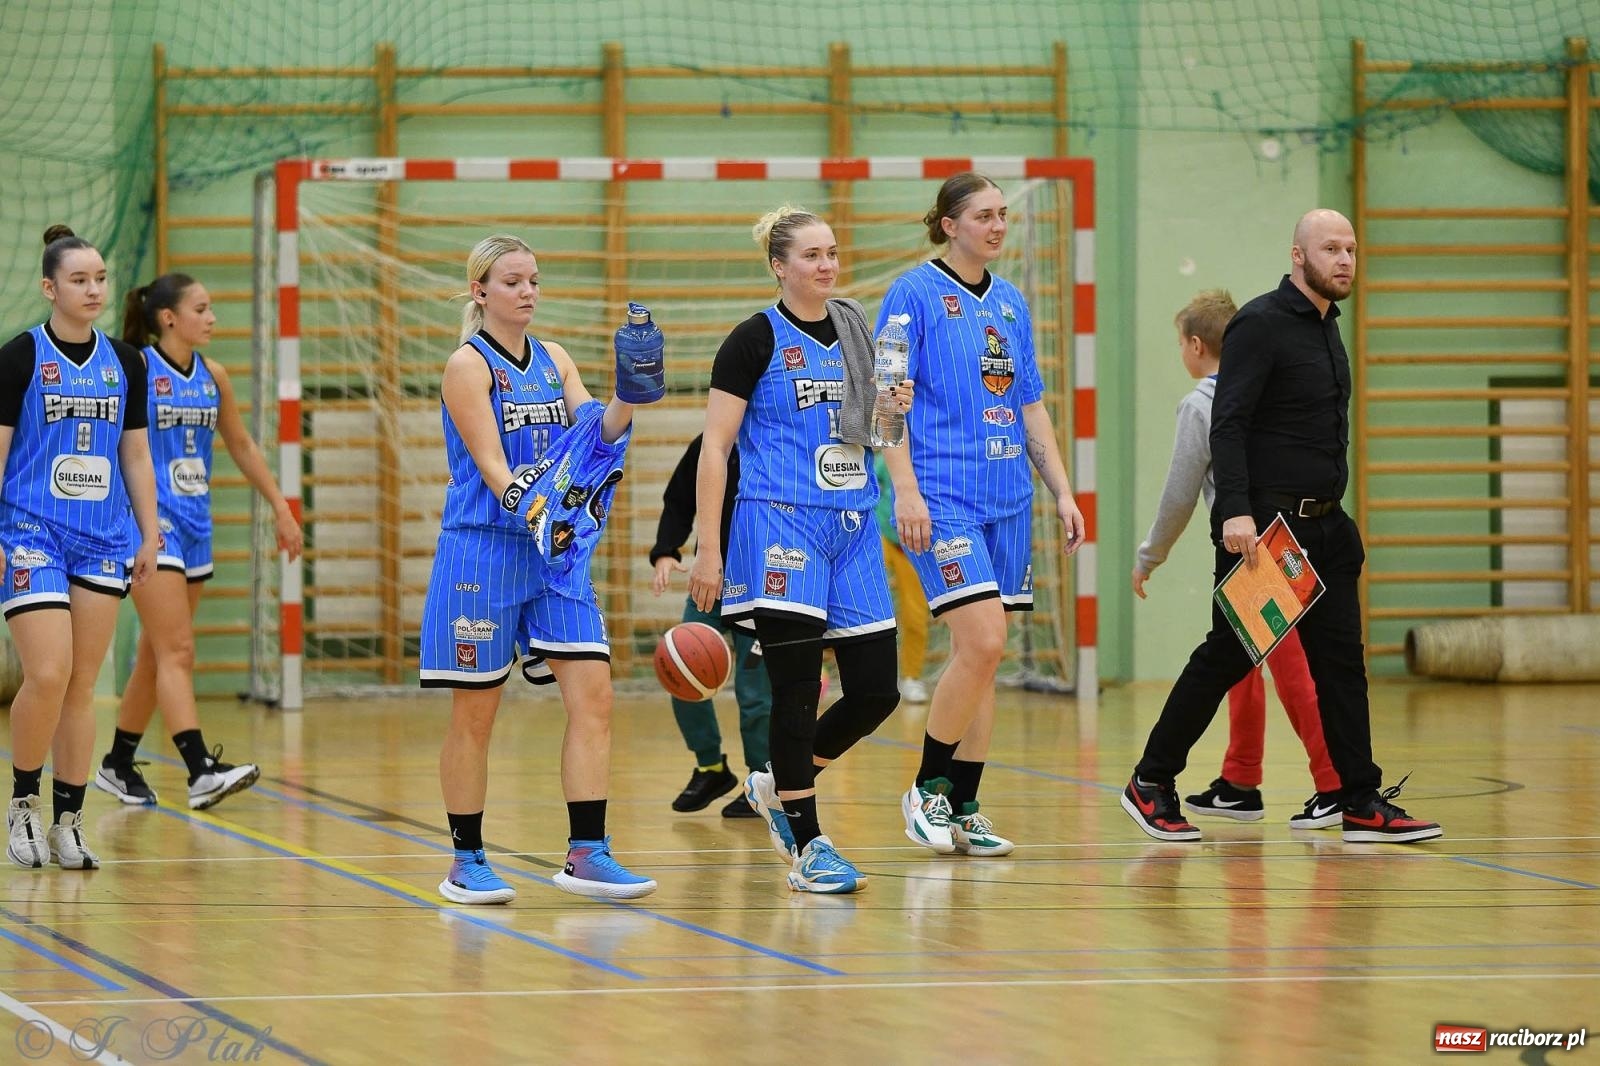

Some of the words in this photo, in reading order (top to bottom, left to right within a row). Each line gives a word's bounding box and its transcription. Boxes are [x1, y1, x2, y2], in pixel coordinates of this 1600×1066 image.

[44, 394, 120, 424] SPARTA
[156, 404, 218, 432] SPARTA
[502, 398, 569, 432] SPARTA
[76, 422, 92, 452] 0
[58, 472, 102, 483] SILESIAN
[824, 462, 860, 473] SILESIAN
[457, 625, 492, 633] POL-GRAM
